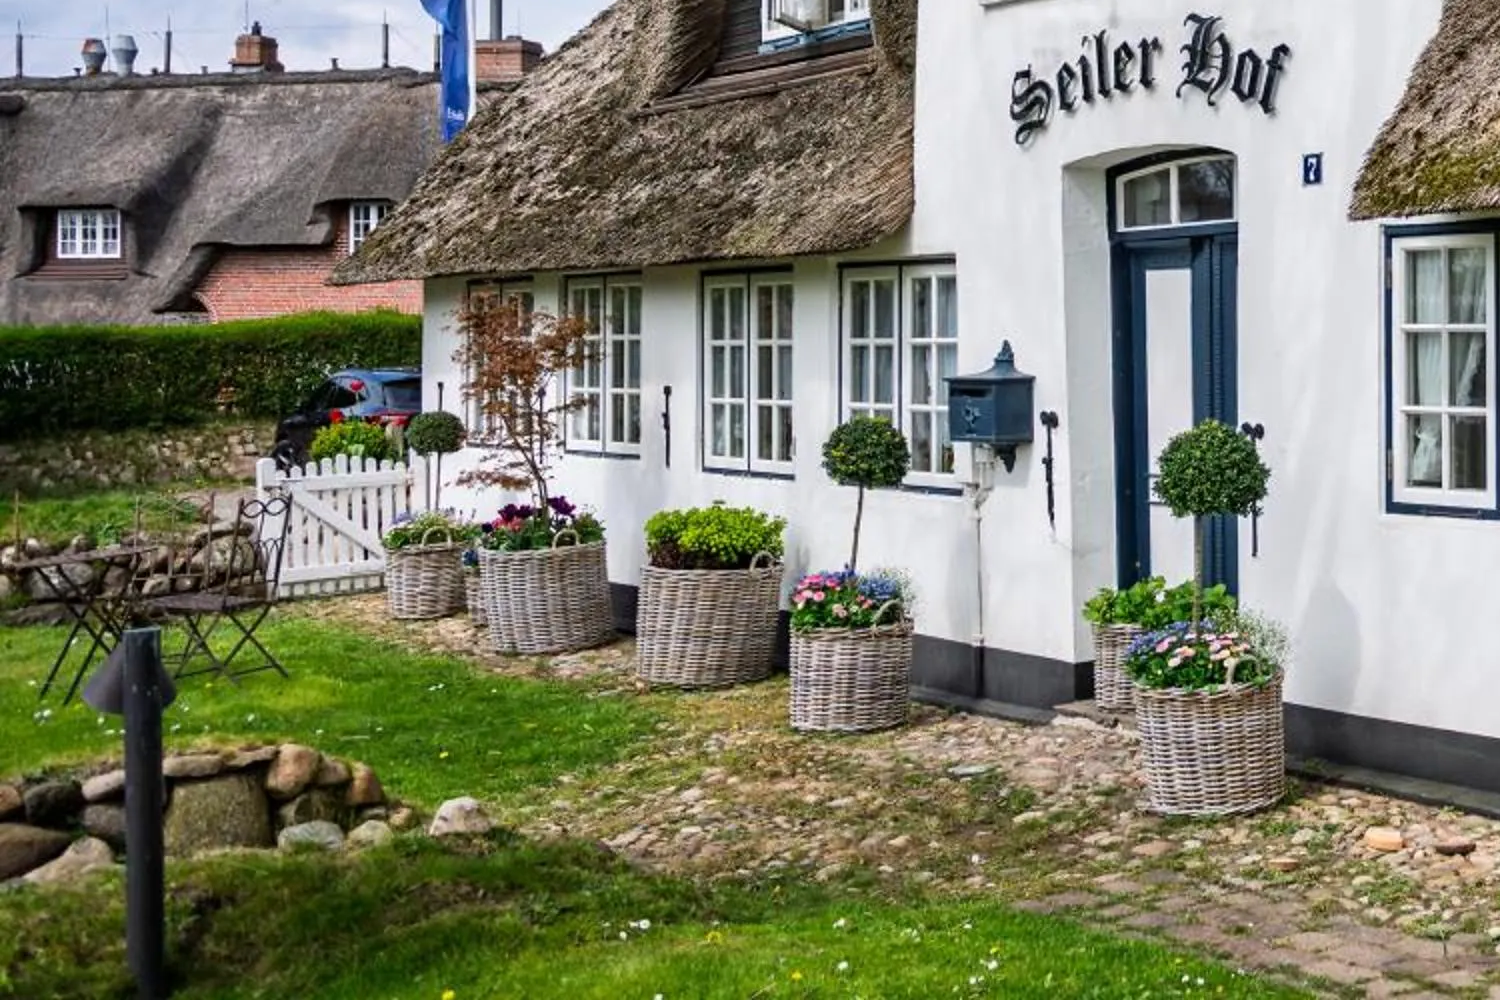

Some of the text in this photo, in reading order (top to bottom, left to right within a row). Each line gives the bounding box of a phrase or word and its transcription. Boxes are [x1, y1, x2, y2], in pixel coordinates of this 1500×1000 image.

[1010, 13, 1290, 144] Seiler Hof
[1307, 157, 1317, 181] 7
